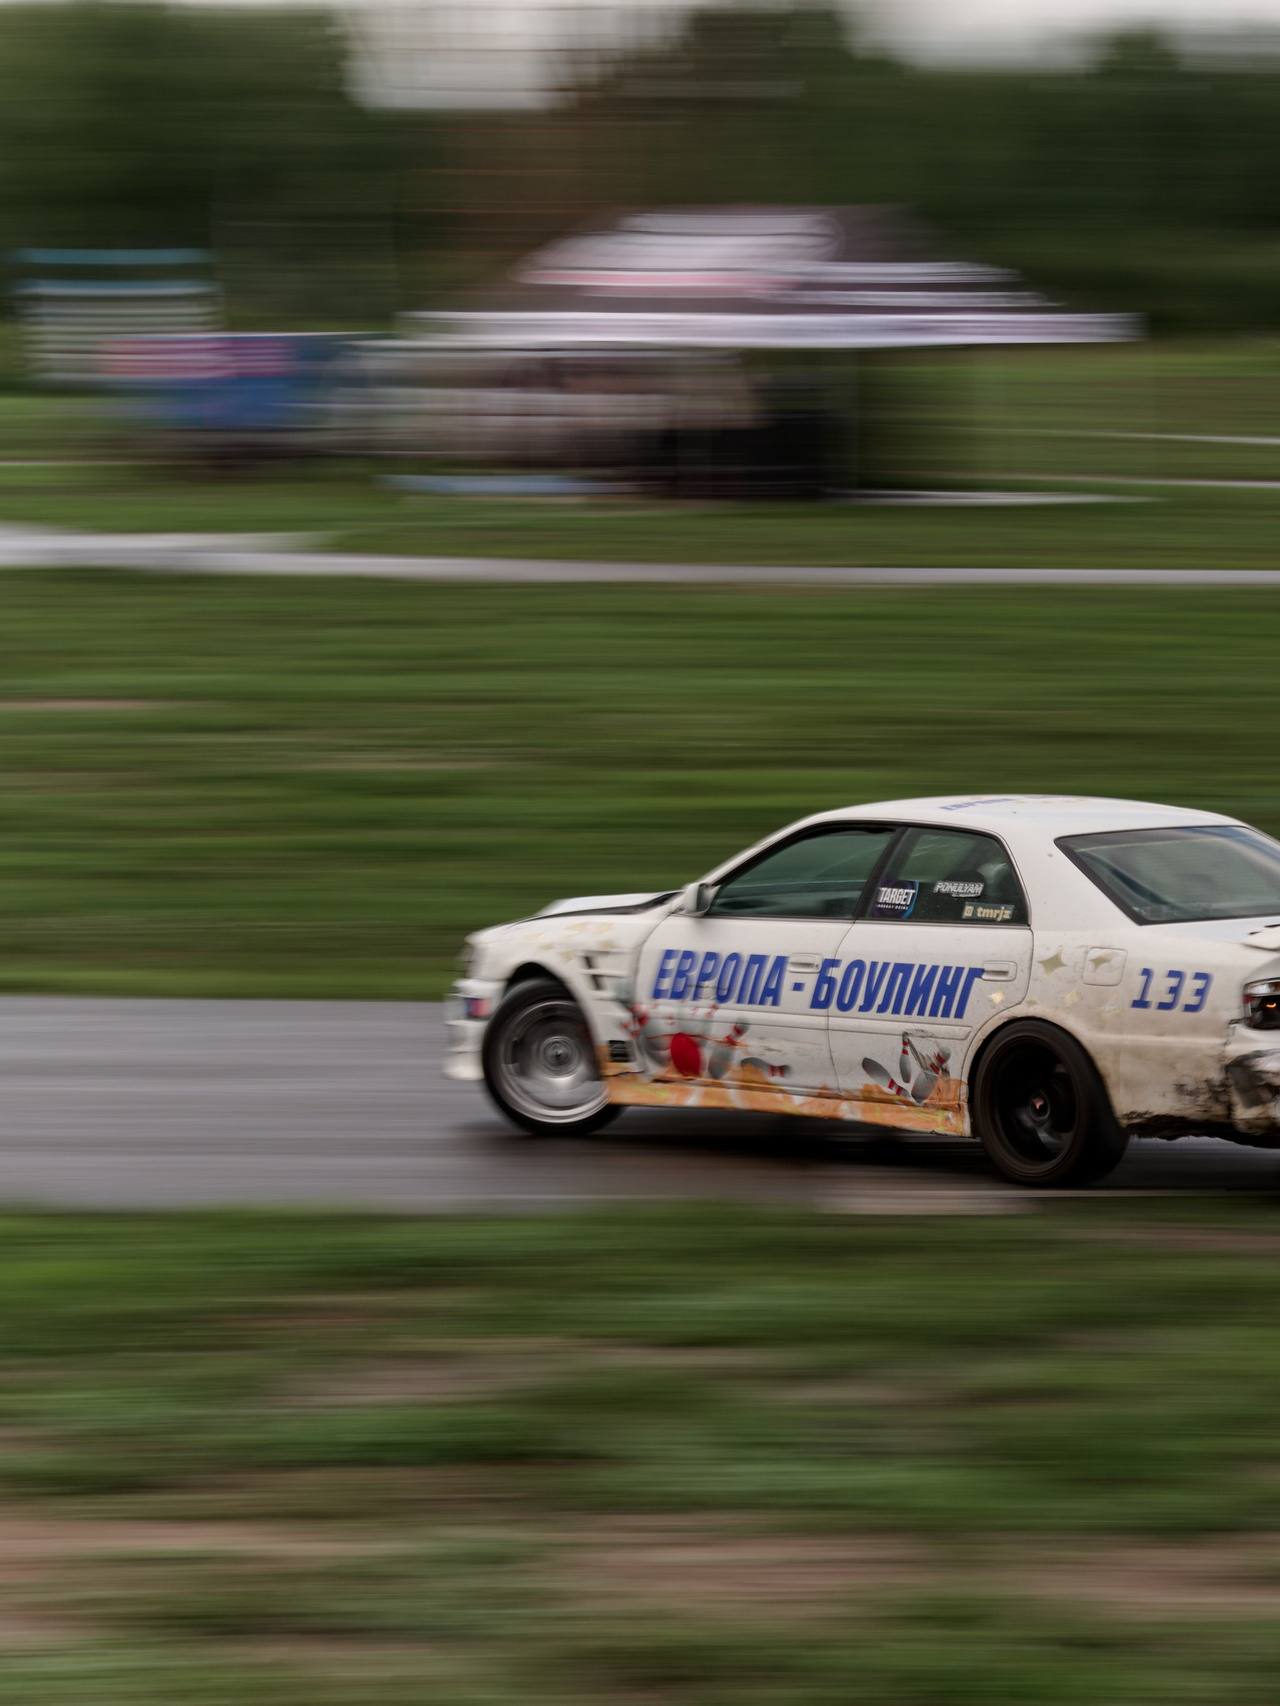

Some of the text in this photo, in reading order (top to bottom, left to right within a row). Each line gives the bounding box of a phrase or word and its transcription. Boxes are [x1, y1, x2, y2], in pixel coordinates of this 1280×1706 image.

[877, 886, 916, 905] TARGET
[977, 906, 1012, 922] tmrjz
[652, 948, 789, 1006] ЕВРОПА
[809, 958, 985, 1019] БОУЛИНГ
[1130, 967, 1213, 1014] 133
